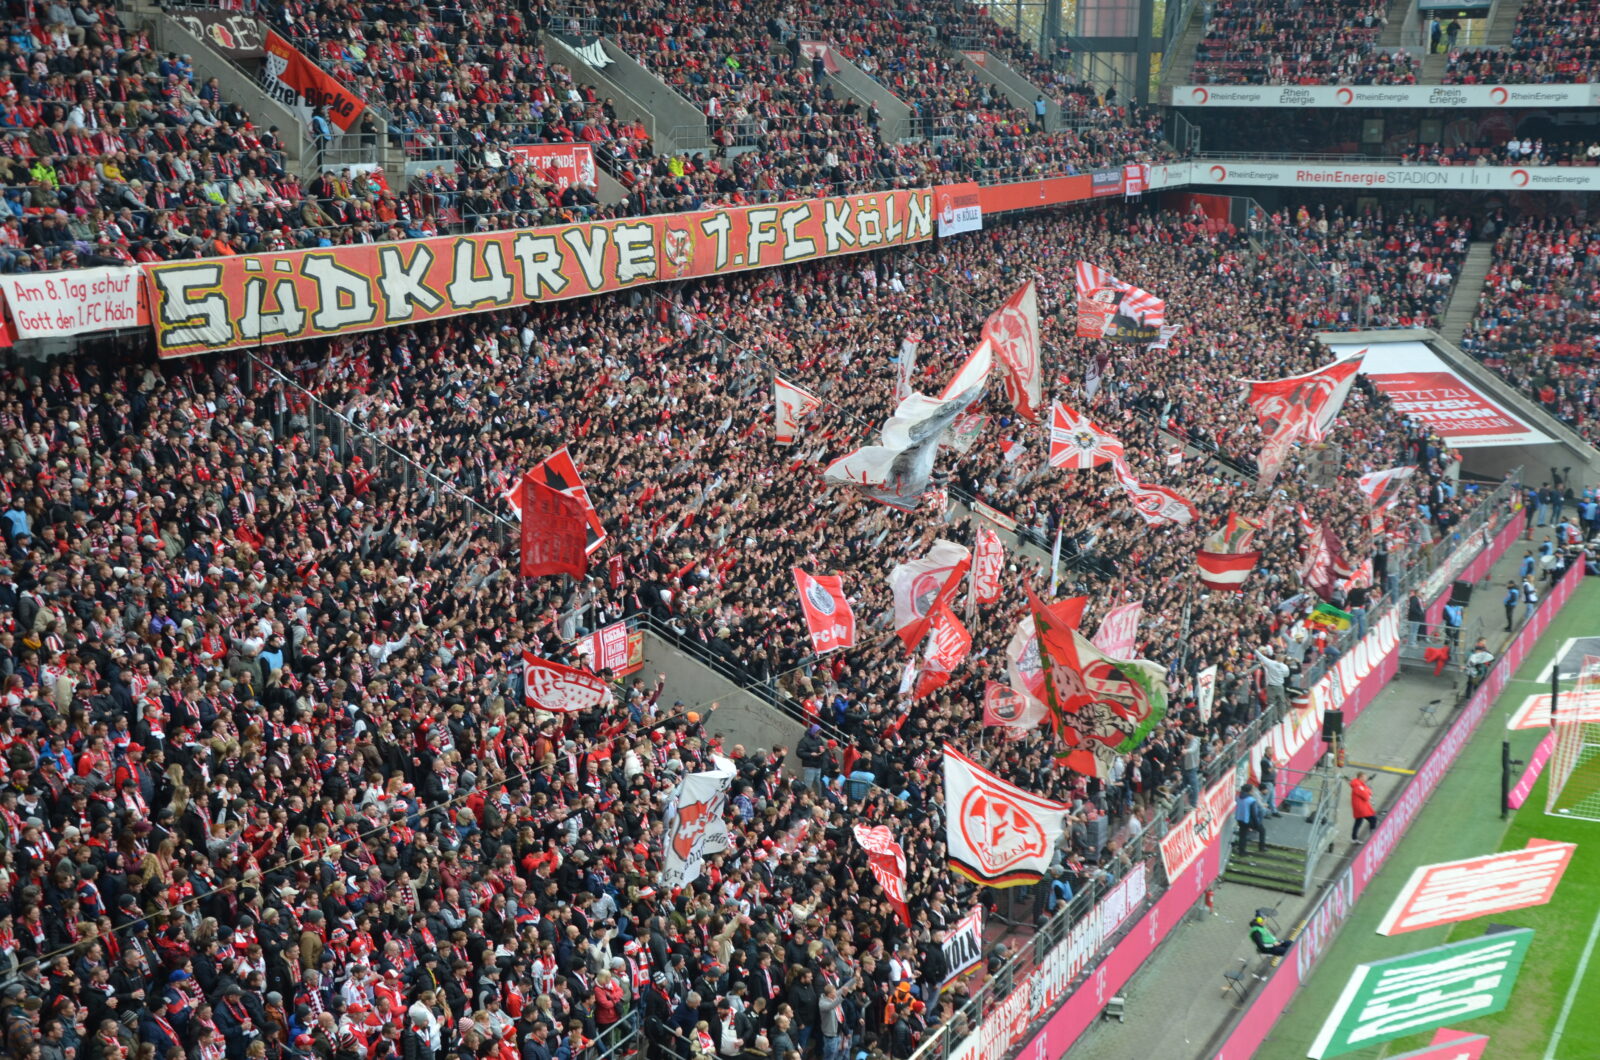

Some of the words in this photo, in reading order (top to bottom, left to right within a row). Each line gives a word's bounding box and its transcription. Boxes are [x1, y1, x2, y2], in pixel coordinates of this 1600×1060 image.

[1211, 93, 1260, 101] RheinEnergie
[1284, 88, 1310, 97] Rhein
[1434, 88, 1461, 96] Rhein
[1511, 93, 1568, 101] RheinEnergie
[1280, 95, 1315, 105] Energie
[1356, 93, 1409, 102] RheinEnergie
[1429, 95, 1467, 105] Energie
[1229, 171, 1279, 180] RheinEnergie
[1296, 170, 1448, 186] RheinEnergieSTADION
[1532, 175, 1590, 184] RheinEnergie
[153, 222, 657, 350] SÜDKURVE
[823, 192, 931, 252] KÖLN
[14, 281, 44, 301] Am
[45, 280, 61, 300] 8.
[60, 278, 87, 302] Tag
[92, 273, 130, 295] schuf
[18, 310, 53, 330] Gott
[56, 309, 76, 329] den
[105, 300, 134, 321] Köln
[1386, 389, 1438, 400] ETZT
[1438, 388, 1470, 398] ZU
[1400, 849, 1567, 928] REWE
[942, 927, 981, 976] KÖLN
[1347, 940, 1517, 1045] DEVK
